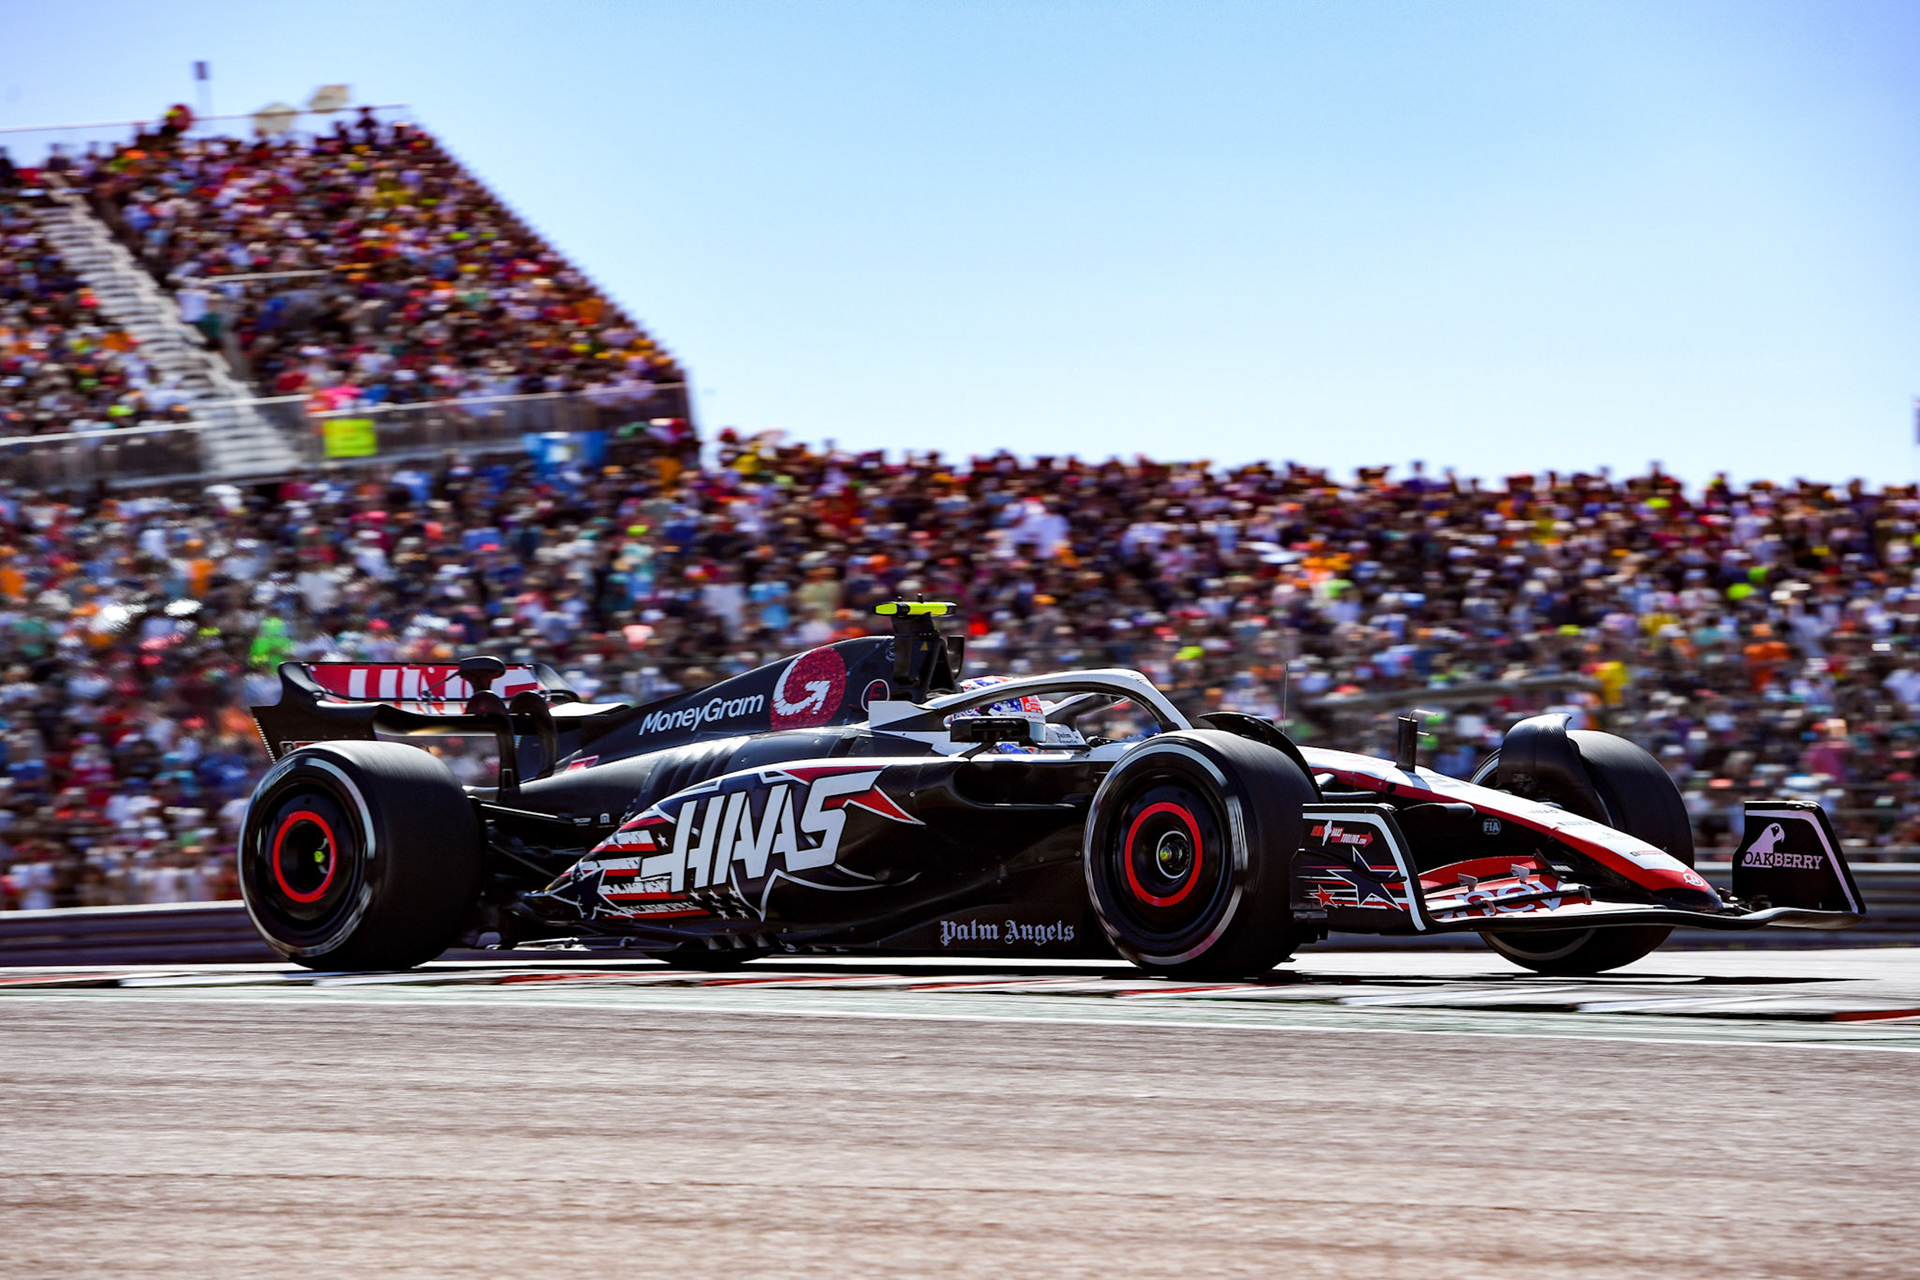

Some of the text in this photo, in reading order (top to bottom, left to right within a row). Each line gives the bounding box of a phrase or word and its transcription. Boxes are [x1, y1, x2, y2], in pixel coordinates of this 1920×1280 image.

[638, 693, 765, 736] MoneyGram
[640, 770, 882, 893] HAAS
[1742, 850, 1824, 871] OAKBERRY
[940, 918, 1076, 947] Palm Angels
